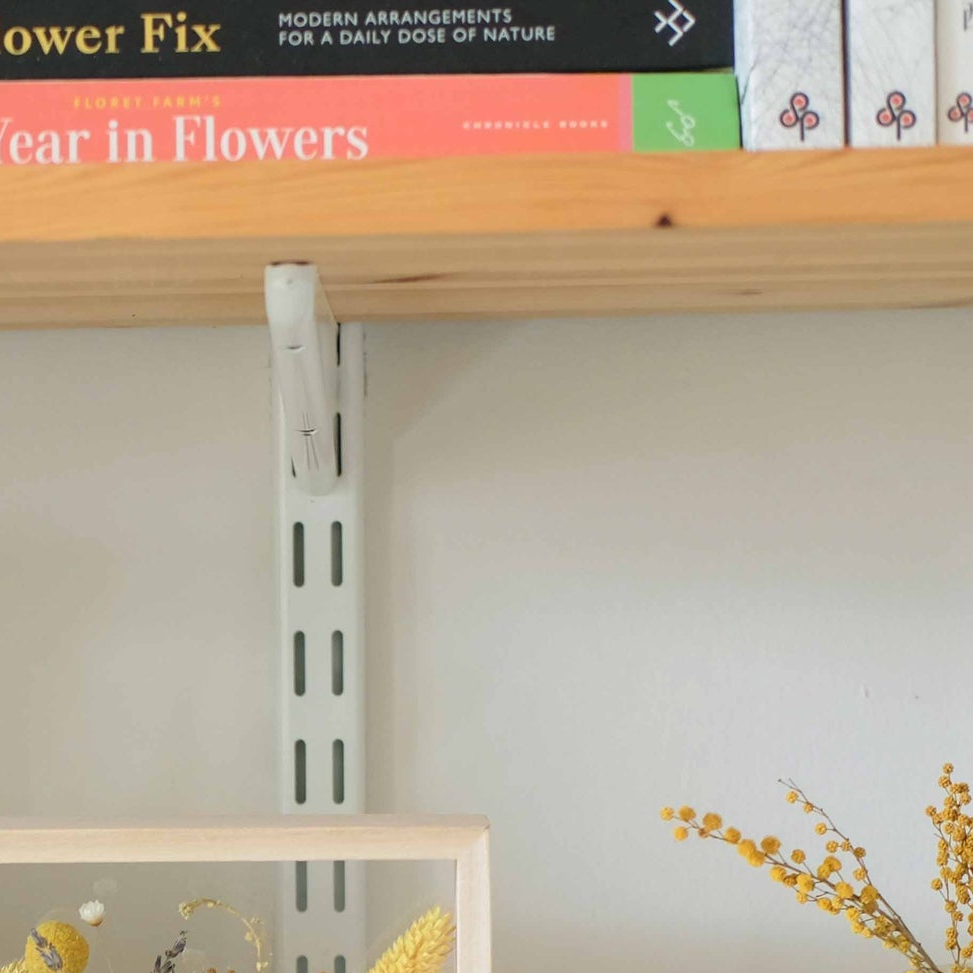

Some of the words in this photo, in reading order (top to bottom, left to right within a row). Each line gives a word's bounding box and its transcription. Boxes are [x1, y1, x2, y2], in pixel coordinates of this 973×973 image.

[278, 11, 358, 28] MODERN
[364, 8, 512, 27] ARRANGEMENTS
[140, 11, 222, 53] Fix
[278, 30, 314, 46] FOR
[321, 30, 333, 46] A
[339, 28, 391, 45] DAILY
[398, 27, 446, 44] DOSE
[452, 27, 477, 44] OF
[483, 26, 555, 42] NATURE
[73, 95, 143, 110] FLORET
[152, 94, 221, 109] FARM'S
[463, 120, 550, 130] CHRONICLE
[559, 120, 608, 129] BOOKS
[106, 118, 154, 163] in
[173, 114, 369, 162] Flowers
